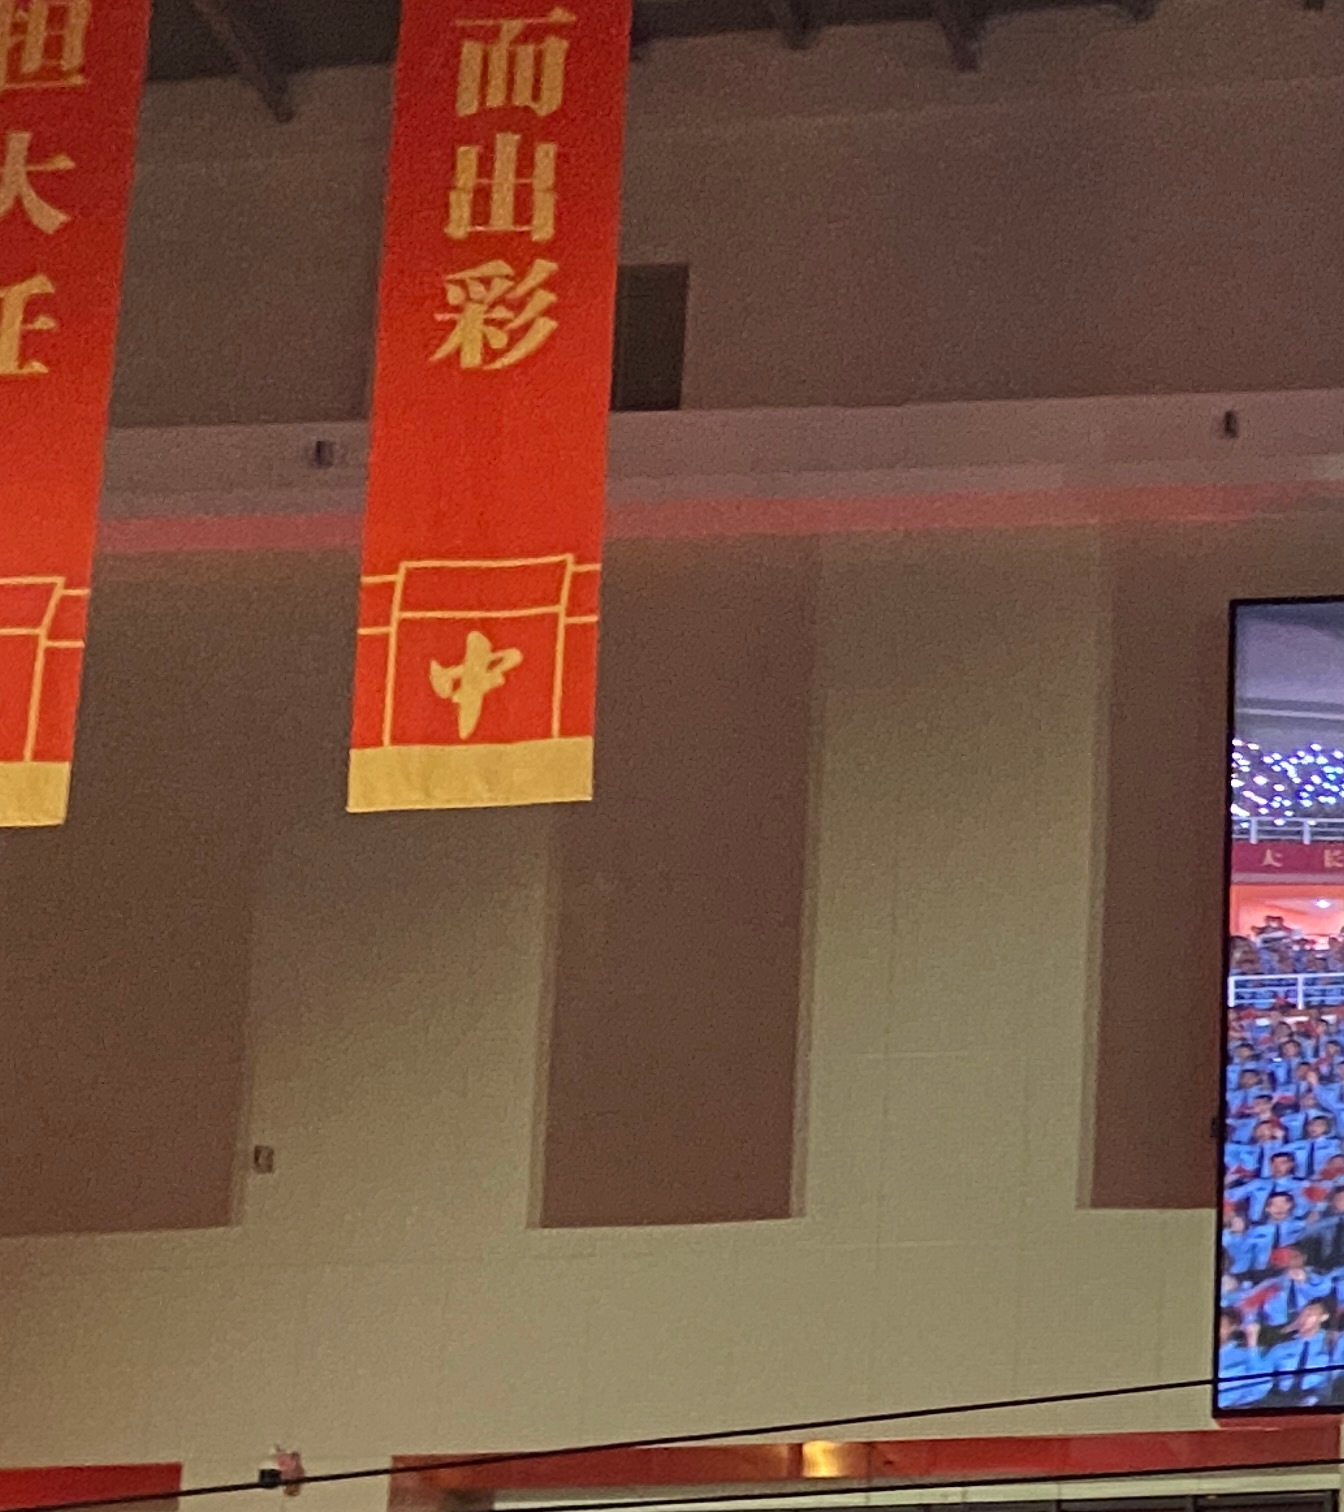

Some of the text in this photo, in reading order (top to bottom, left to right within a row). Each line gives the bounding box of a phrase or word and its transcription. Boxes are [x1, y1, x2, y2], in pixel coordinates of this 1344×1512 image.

[429, 9, 578, 370] 而出彩
[428, 630, 523, 740] 中
